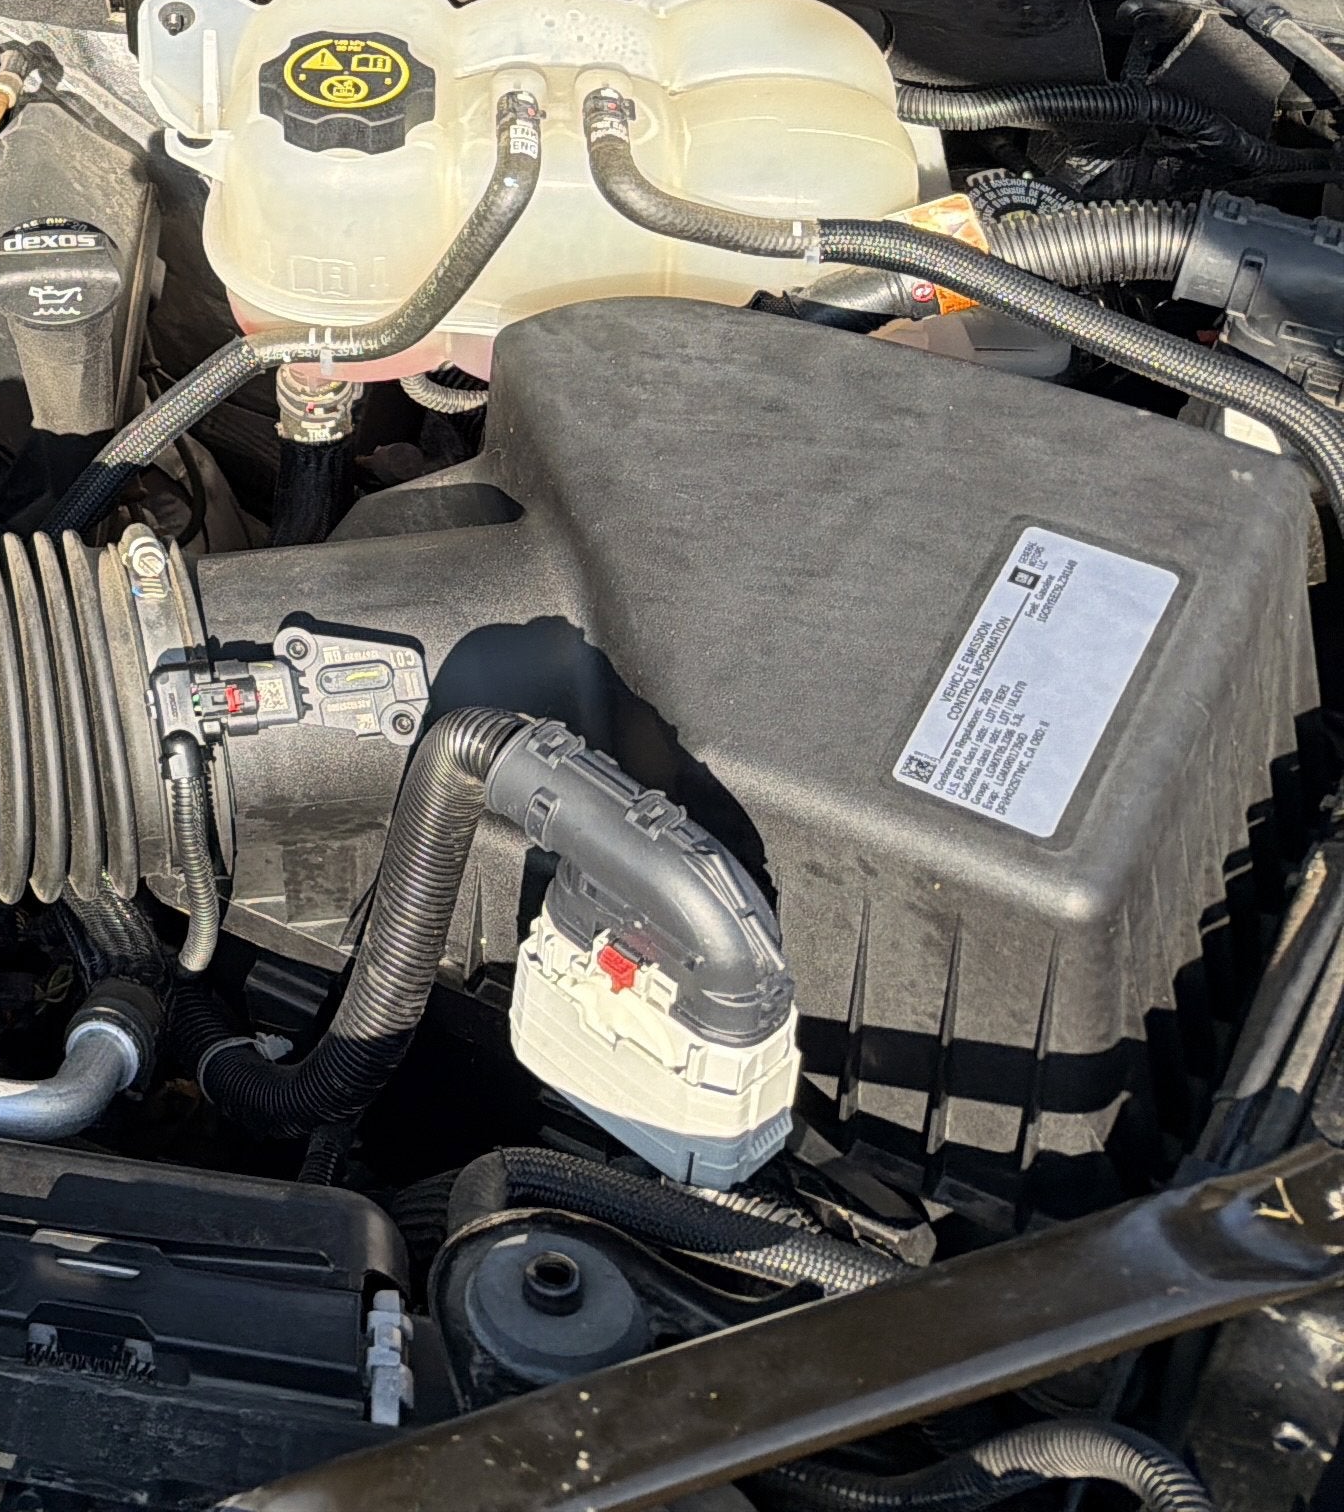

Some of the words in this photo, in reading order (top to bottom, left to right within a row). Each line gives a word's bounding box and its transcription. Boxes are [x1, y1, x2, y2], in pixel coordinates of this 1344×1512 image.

[513, 141, 537, 155] ENG
[1030, 180, 1057, 196] AVANT
[3, 234, 99, 252] dexos
[941, 664, 970, 704] VEHICLE
[961, 621, 994, 665] EMISSION
[946, 676, 980, 722] CONTROL
[971, 615, 1013, 677] INFORMATION
[954, 765, 970, 781] EPA
[962, 746, 980, 766] class
[984, 707, 1000, 724] LDT
[976, 748, 994, 768] class
[998, 709, 1014, 726] LDT
